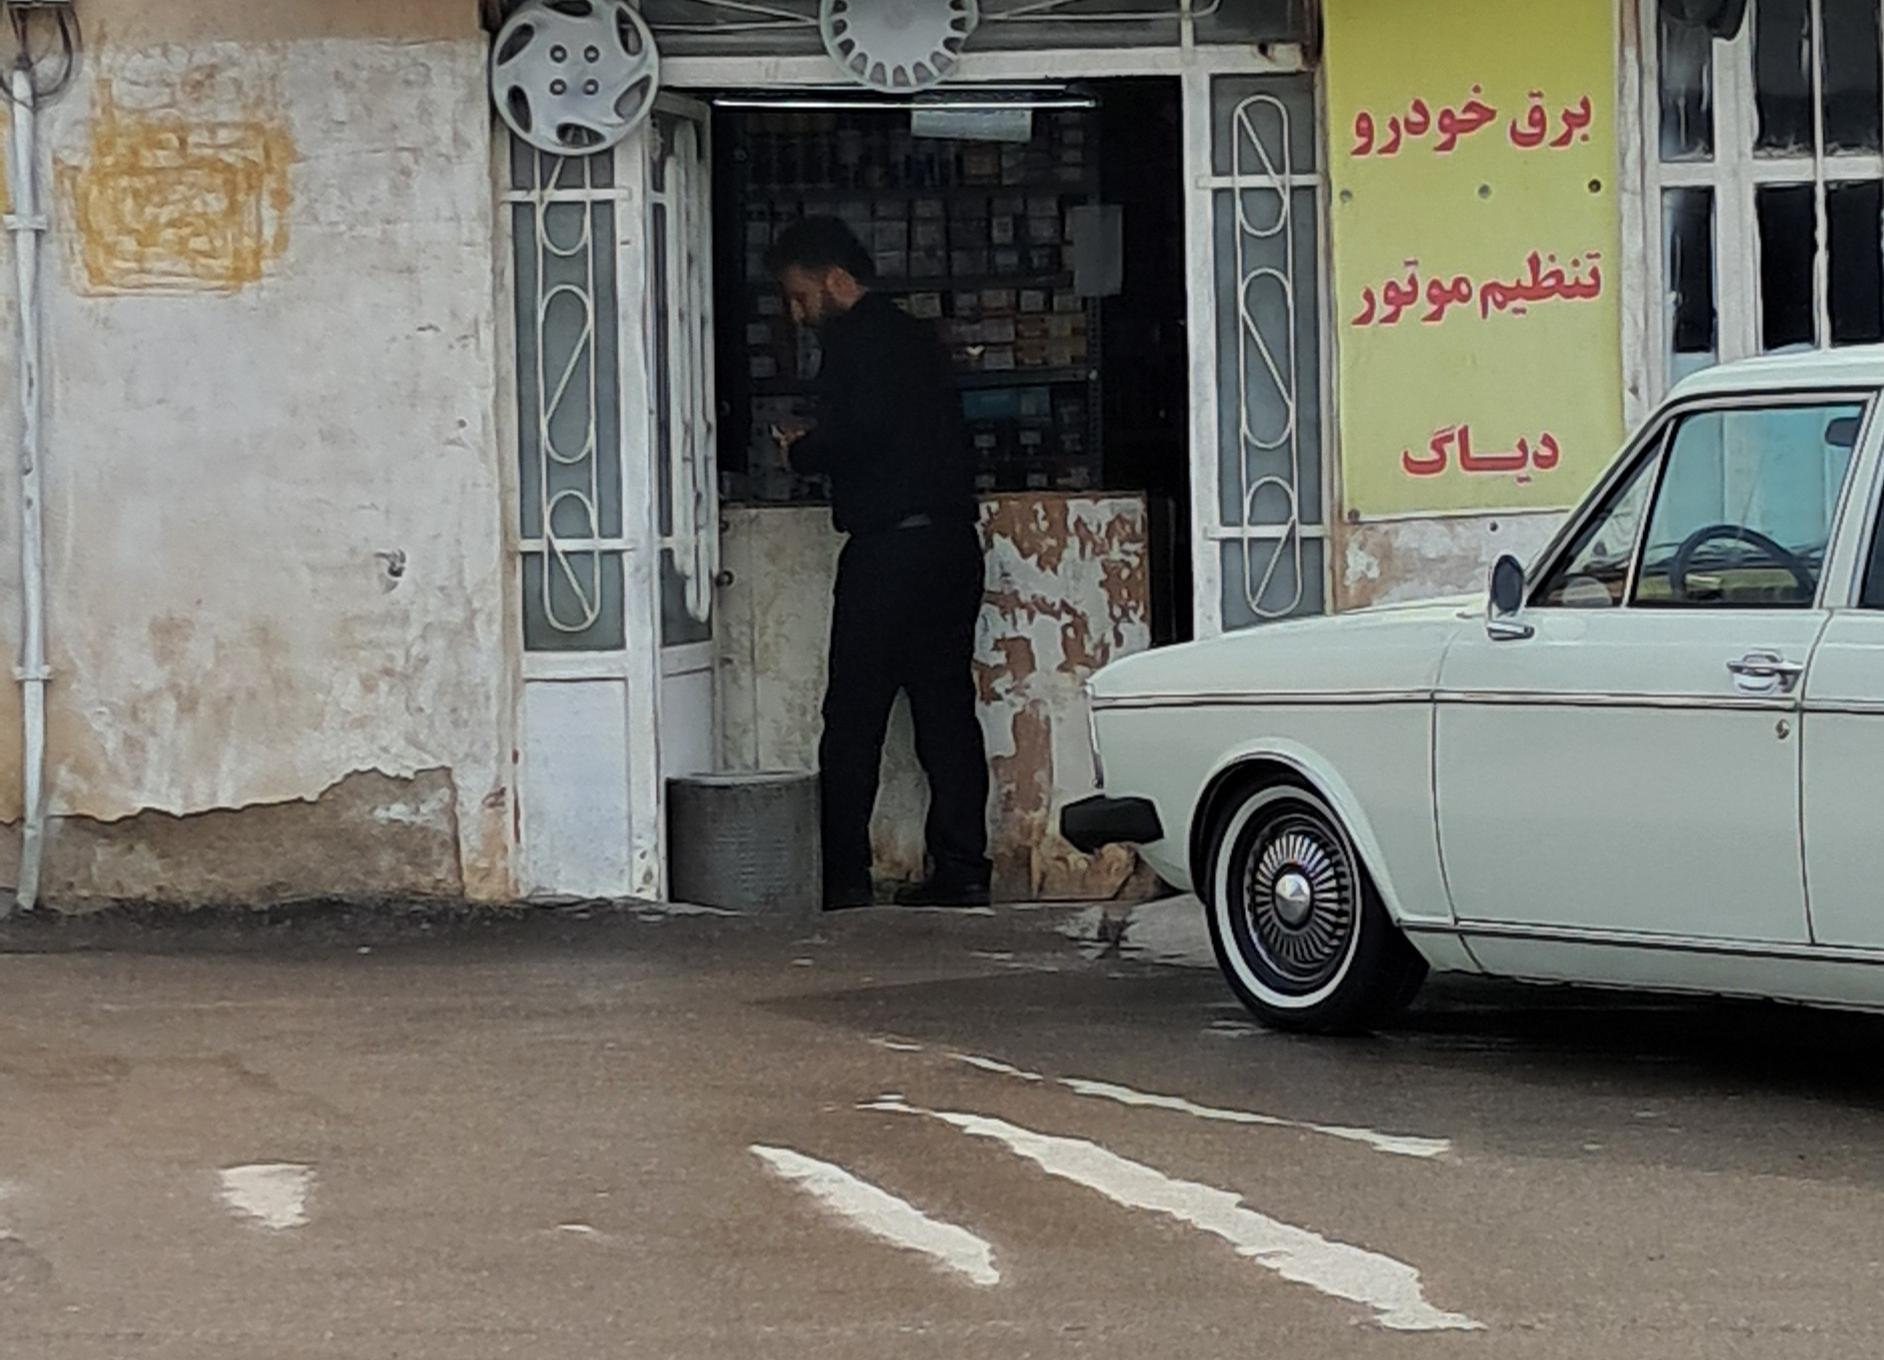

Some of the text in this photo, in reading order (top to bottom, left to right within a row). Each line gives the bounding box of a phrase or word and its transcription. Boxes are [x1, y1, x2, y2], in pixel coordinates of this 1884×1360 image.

[1350, 83, 1593, 157] برق خودرو
[1350, 249, 1602, 326] تنظیم موتور
